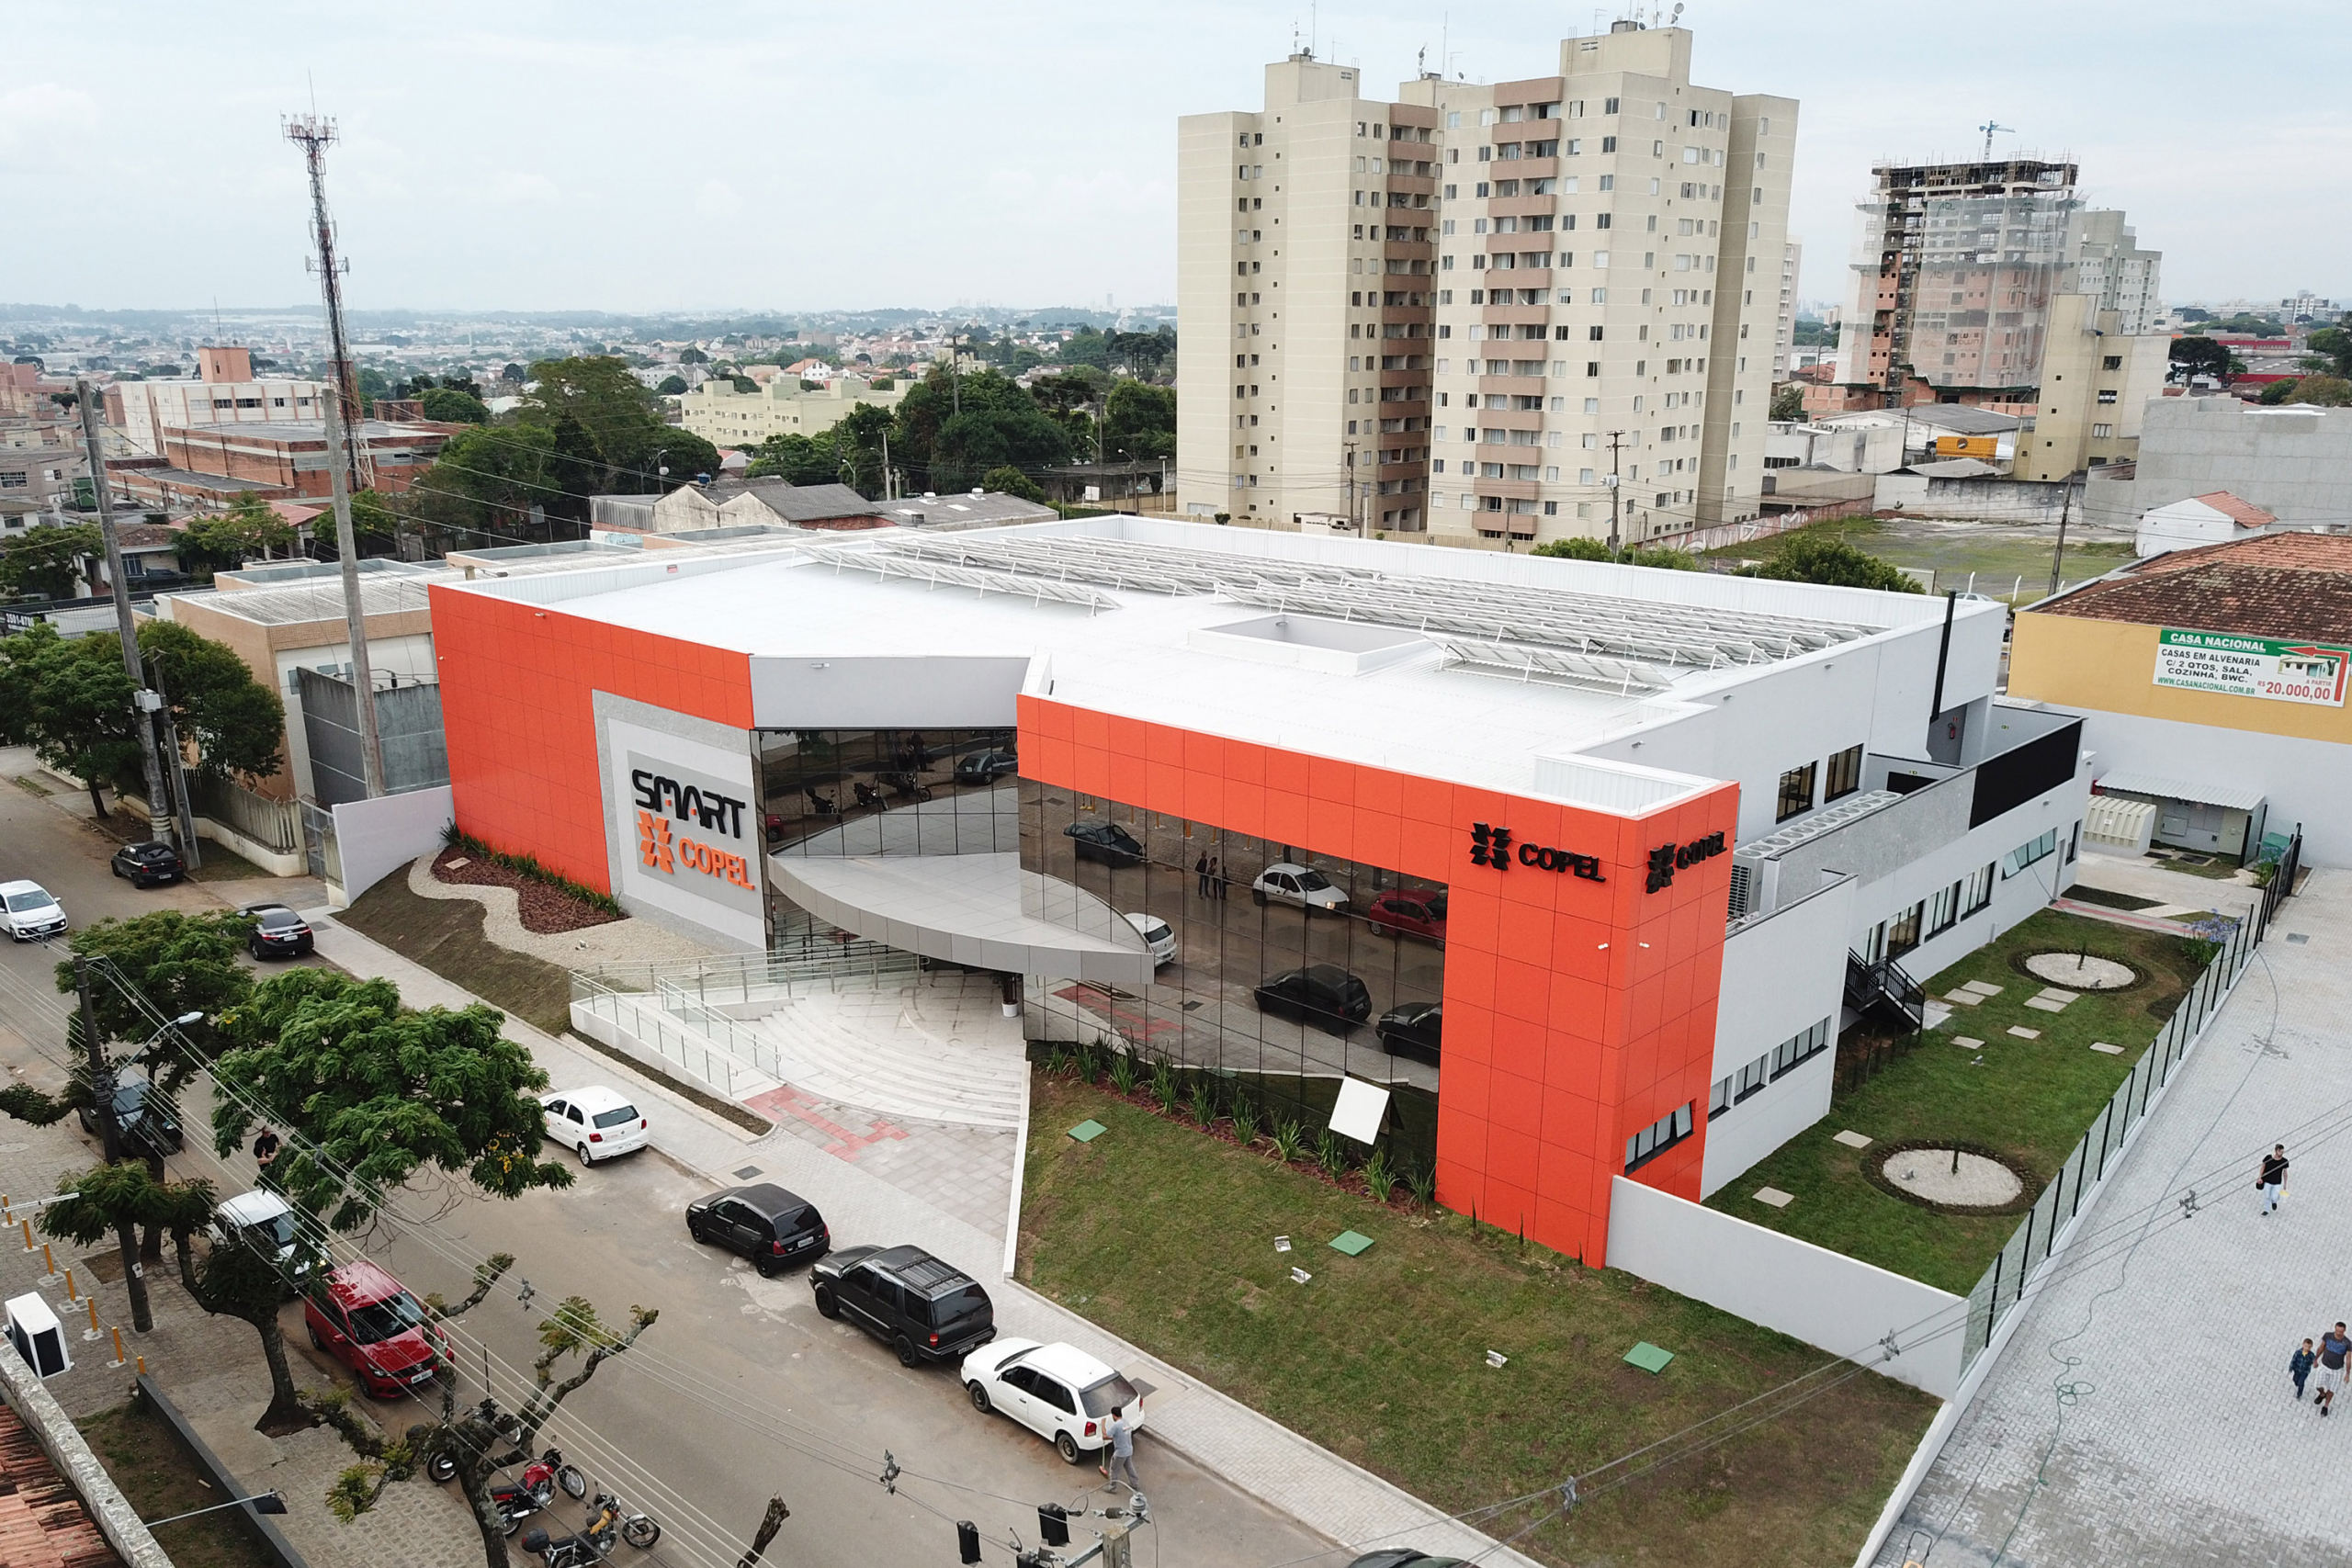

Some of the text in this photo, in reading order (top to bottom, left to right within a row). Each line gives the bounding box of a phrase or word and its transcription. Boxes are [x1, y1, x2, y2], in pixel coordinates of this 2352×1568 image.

[2170, 633, 2267, 651] CASA NACIONAL
[2161, 649, 2260, 667] CASAS EM ALVENARIA
[2165, 659, 2177, 667] C/
[2188, 661, 2219, 672] QTOS,
[2222, 665, 2253, 677] SALA,
[2167, 667, 2248, 683] COZINHA, BWC.
[2157, 676, 2256, 695] WWW.CASANACIONAL.COM.BR
[2257, 680, 2331, 702] R$ 20.000,00
[2311, 679, 2333, 687] PARTIR
[631, 768, 746, 840] SMART
[1676, 830, 1728, 870] COPEL
[678, 836, 756, 891] COPEL
[1518, 841, 1607, 884] COPEL
